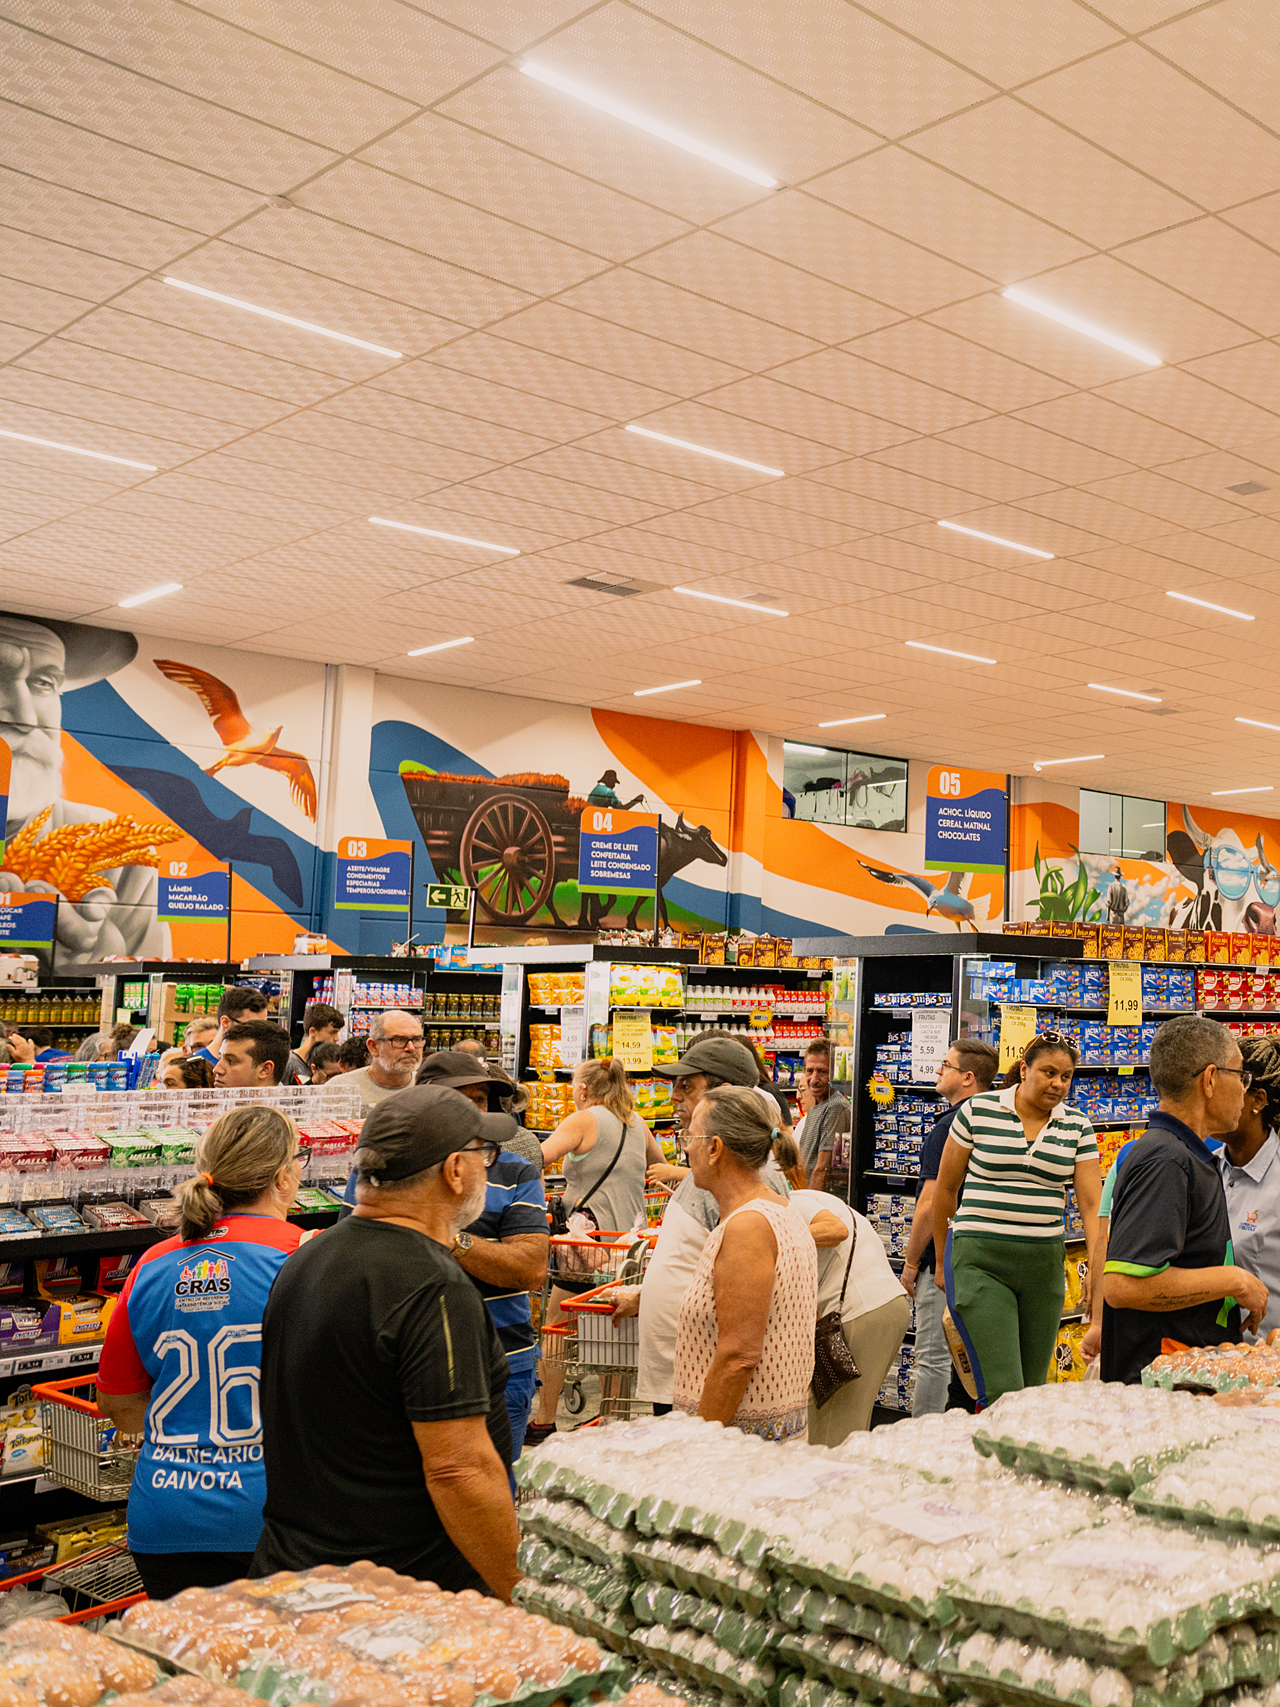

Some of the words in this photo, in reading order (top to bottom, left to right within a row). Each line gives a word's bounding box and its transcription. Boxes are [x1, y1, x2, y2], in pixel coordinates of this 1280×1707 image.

[939, 771, 961, 796] 05
[938, 807, 963, 817] ACHOC.
[964, 808, 992, 819] LÍQUIDO
[593, 811, 613, 832] 04
[938, 819, 962, 829] CEREAL
[963, 821, 991, 831] MATINAL
[938, 830, 980, 841] CHOCOLATES
[347, 840, 367, 857] 03
[591, 841, 613, 850] CREME
[613, 842, 622, 850] DE
[623, 843, 638, 852] LEITE
[591, 850, 631, 861] CONFEITARIA
[169, 861, 188, 877] 02
[347, 865, 390, 873] AZEITE/VINAGRE
[590, 860, 607, 868] LEITE
[607, 861, 651, 871] CONDENSADO
[346, 872, 386, 880] CONDIMENTOS
[590, 870, 631, 879] SOBREMESAS
[168, 884, 192, 893] LÁMEN
[346, 887, 406, 896] TEMPEROS/CONSERVAS
[168, 893, 208, 902] MACARRÃO
[168, 902, 194, 911] QUEIJO
[195, 903, 224, 911] RALADO
[1030, 985, 1045, 994] LACTA
[1114, 1000, 1139, 1012] 11,99
[920, 1046, 934, 1055] 5,59
[1006, 1046, 1025, 1060] 11,9
[919, 1066, 934, 1075] 4,99
[16, 1157, 48, 1165] HALLS
[74, 1155, 104, 1163] HALLS
[129, 1152, 157, 1160] HALLS
[175, 1278, 231, 1296] CRAS
[150, 1323, 263, 1447] 26
[152, 1469, 243, 1490] GAIVOTA
